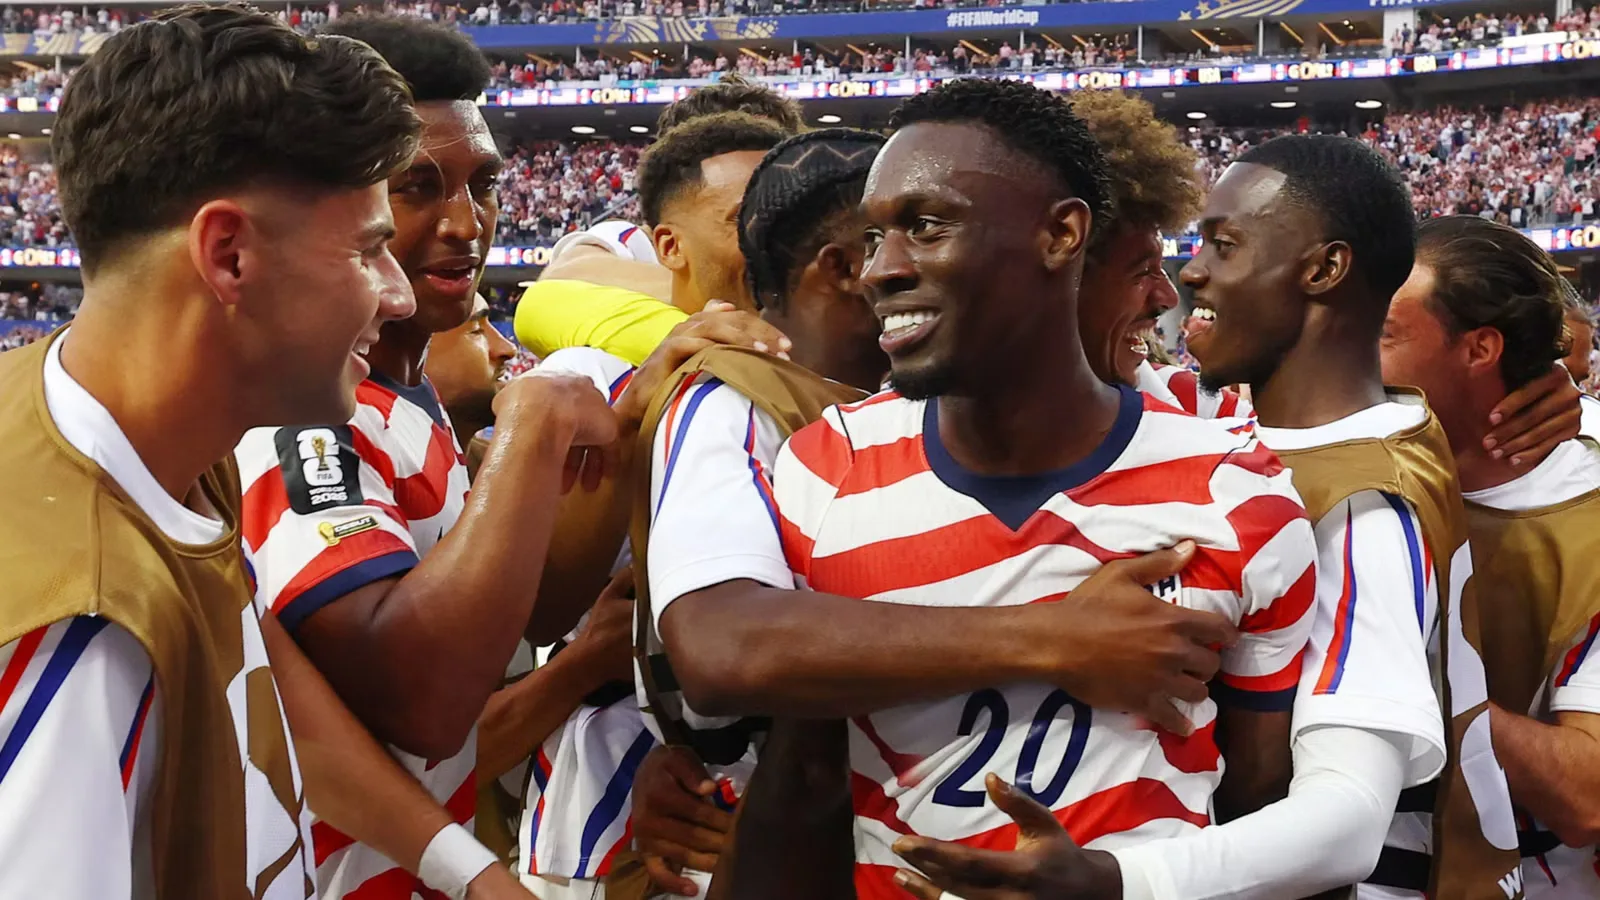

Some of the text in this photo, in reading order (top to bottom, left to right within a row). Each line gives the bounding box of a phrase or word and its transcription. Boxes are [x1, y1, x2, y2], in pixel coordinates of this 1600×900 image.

[946, 9, 1040, 27] #FIFAWorldCup
[316, 472, 333, 480] FIFA
[311, 492, 348, 505] 2026
[931, 687, 1092, 808] 20
